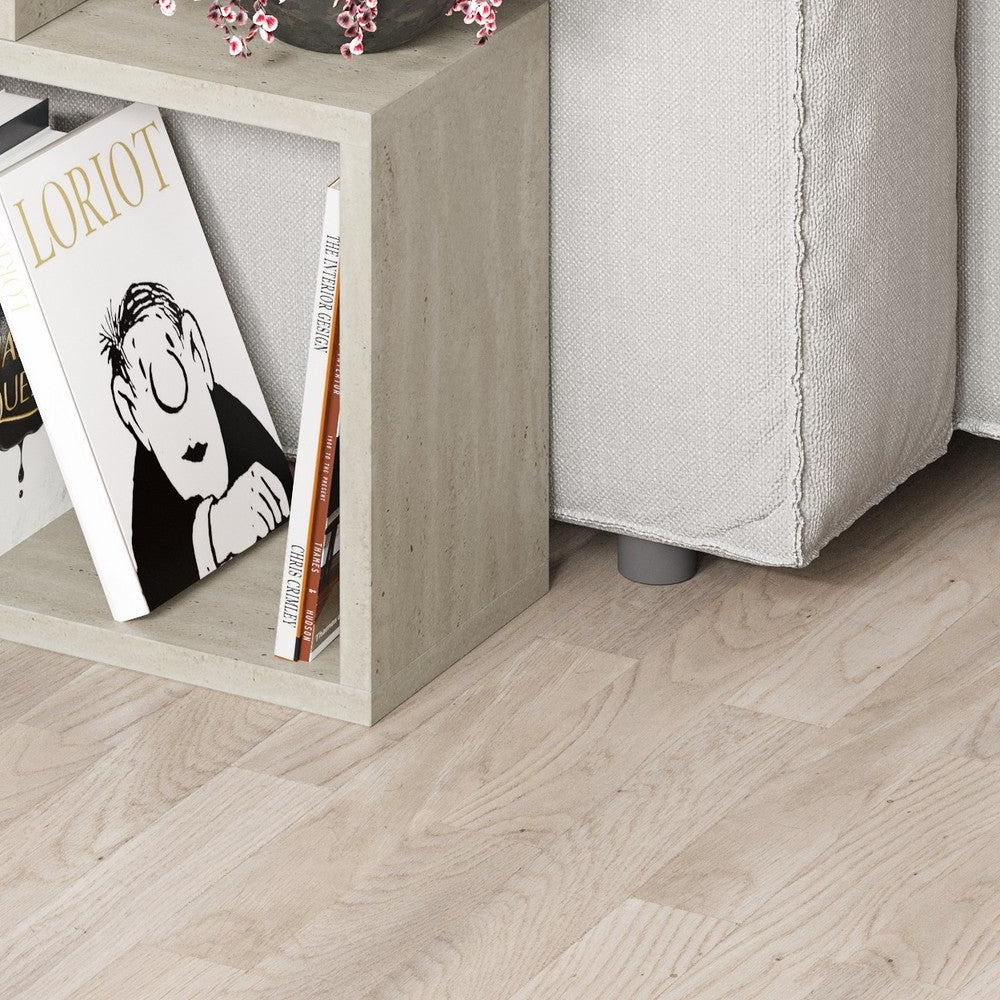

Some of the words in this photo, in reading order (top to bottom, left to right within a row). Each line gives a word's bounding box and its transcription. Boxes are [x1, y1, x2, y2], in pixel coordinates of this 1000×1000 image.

[14, 121, 170, 269] LORIOT
[325, 235, 340, 258] THE
[319, 258, 337, 311] INTERIOR
[288, 545, 305, 579] CHRIS
[311, 542, 323, 573] THAMES
[282, 580, 301, 628] CRIMLEY
[303, 609, 314, 642] HUDSON
